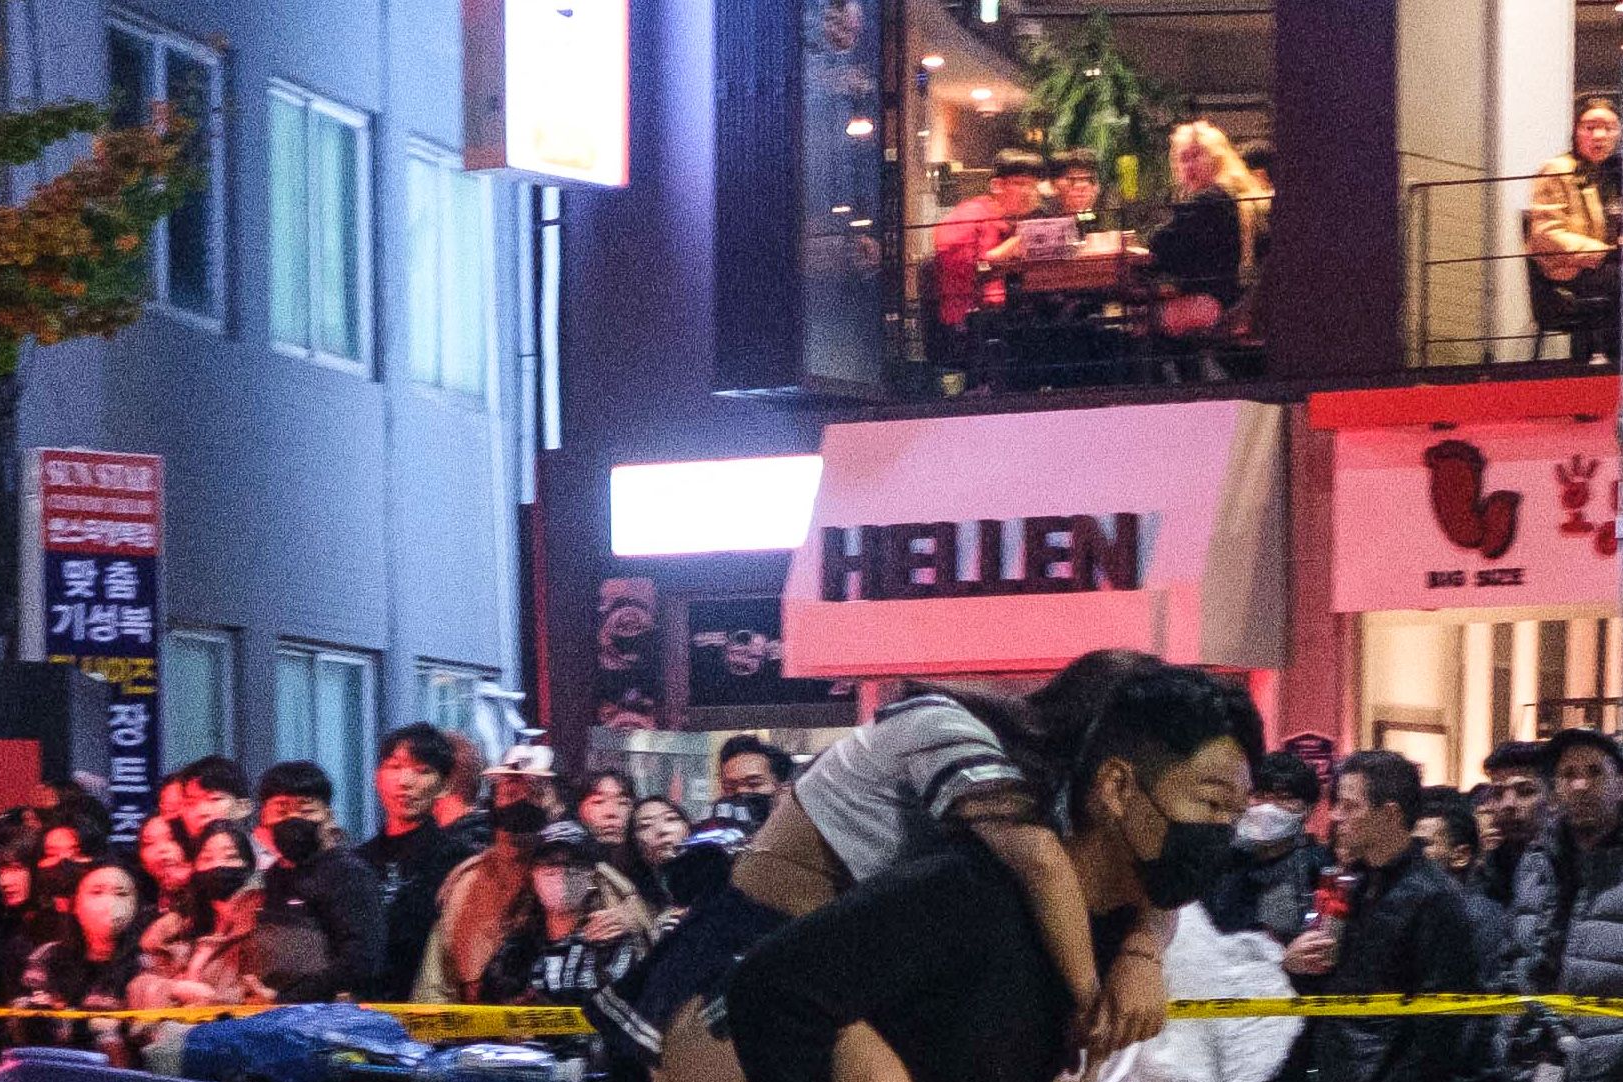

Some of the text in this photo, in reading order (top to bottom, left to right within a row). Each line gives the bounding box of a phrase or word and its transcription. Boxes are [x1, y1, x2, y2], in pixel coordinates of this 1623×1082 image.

[821, 513, 1139, 601] HELLEN
[1475, 568, 1526, 587] SIZE
[50, 603, 154, 643] 기성복
